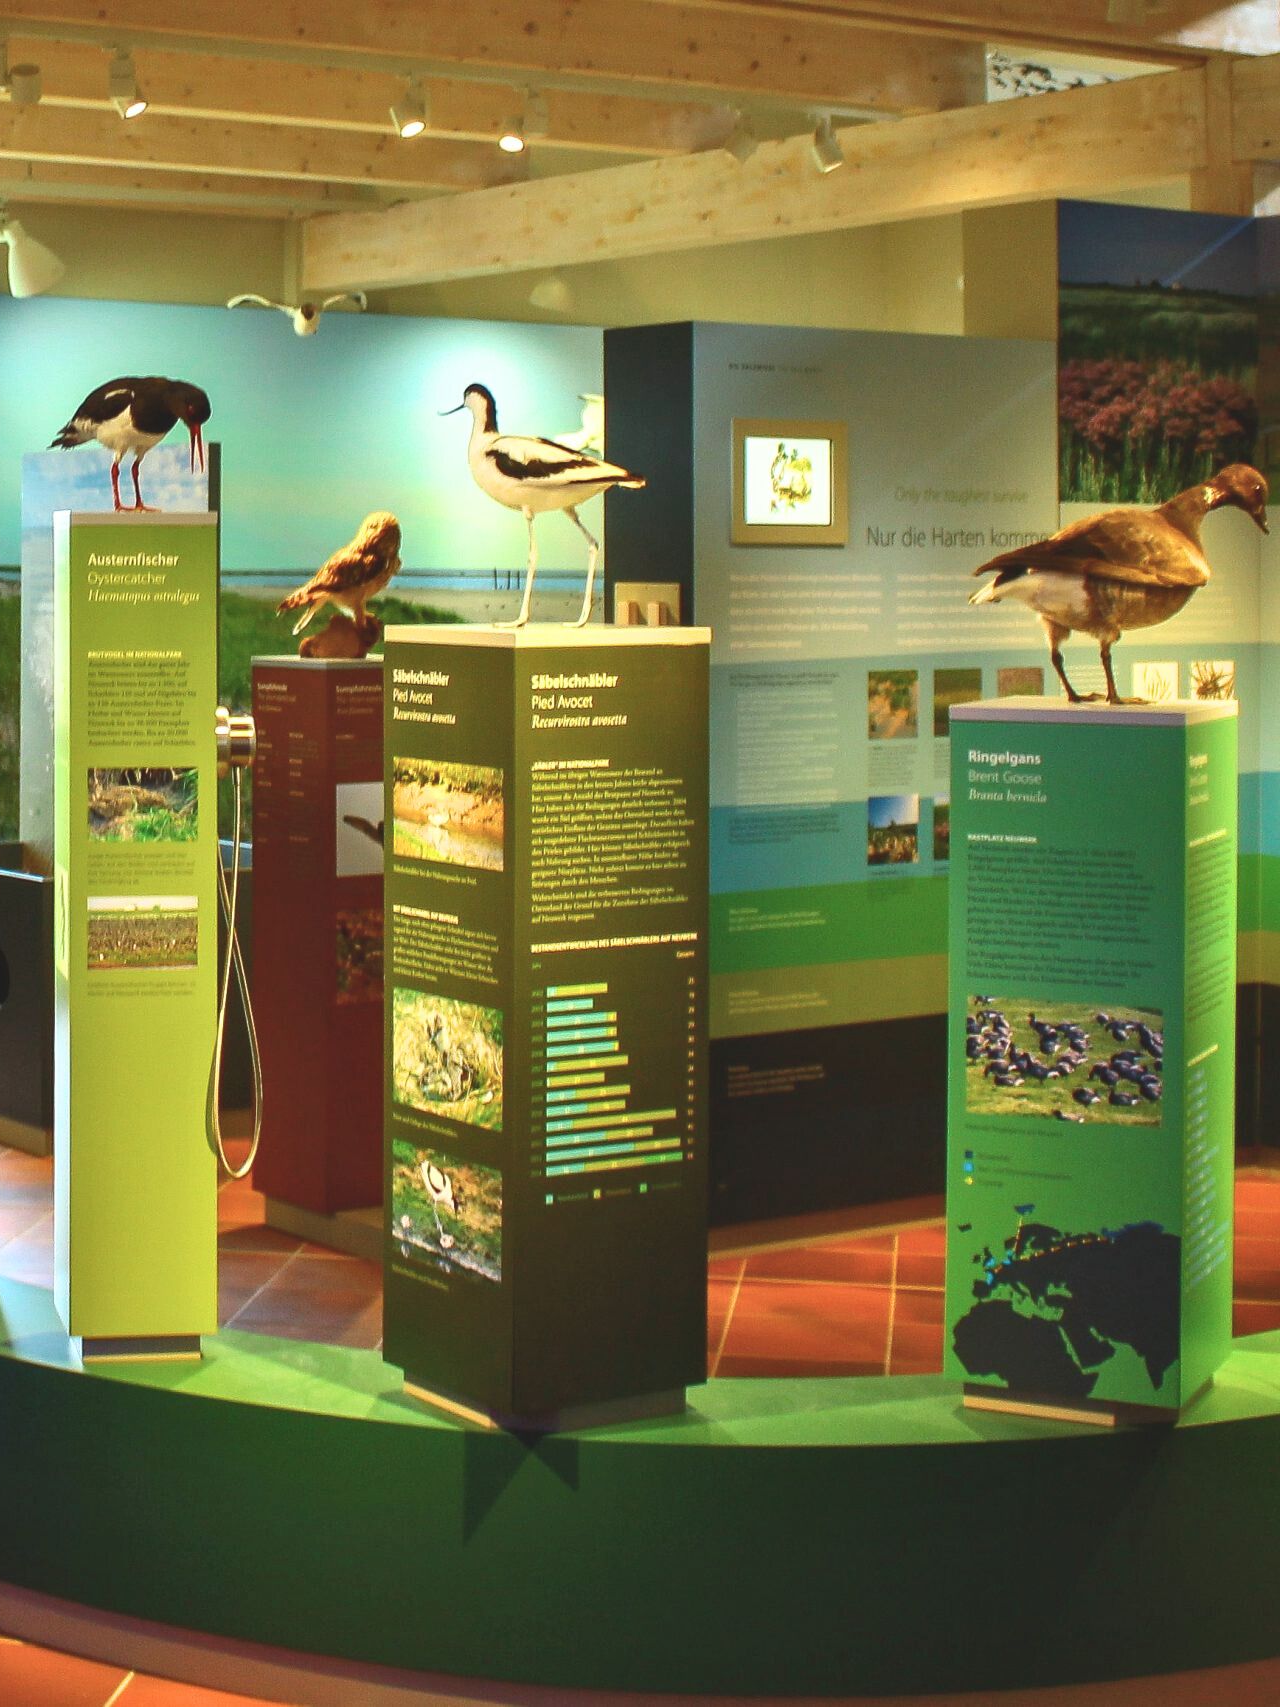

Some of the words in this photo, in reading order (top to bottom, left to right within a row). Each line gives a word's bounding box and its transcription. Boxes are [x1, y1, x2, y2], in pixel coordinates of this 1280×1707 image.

[867, 527, 897, 546] Nur
[901, 526, 926, 547] die
[932, 527, 985, 547] Harten
[991, 528, 1049, 546] komme
[87, 552, 179, 567] Austernfischer
[87, 571, 167, 586] Oystercatcher
[88, 588, 151, 605] Haematopus
[135, 650, 183, 659] NATIONALPARK
[531, 672, 619, 690] Säbelschnäbler
[531, 695, 554, 710] Pied
[557, 694, 593, 708] Avocet
[968, 750, 1043, 768] Ringelgans
[968, 769, 1000, 783] Brent
[1003, 770, 1043, 785] Goose
